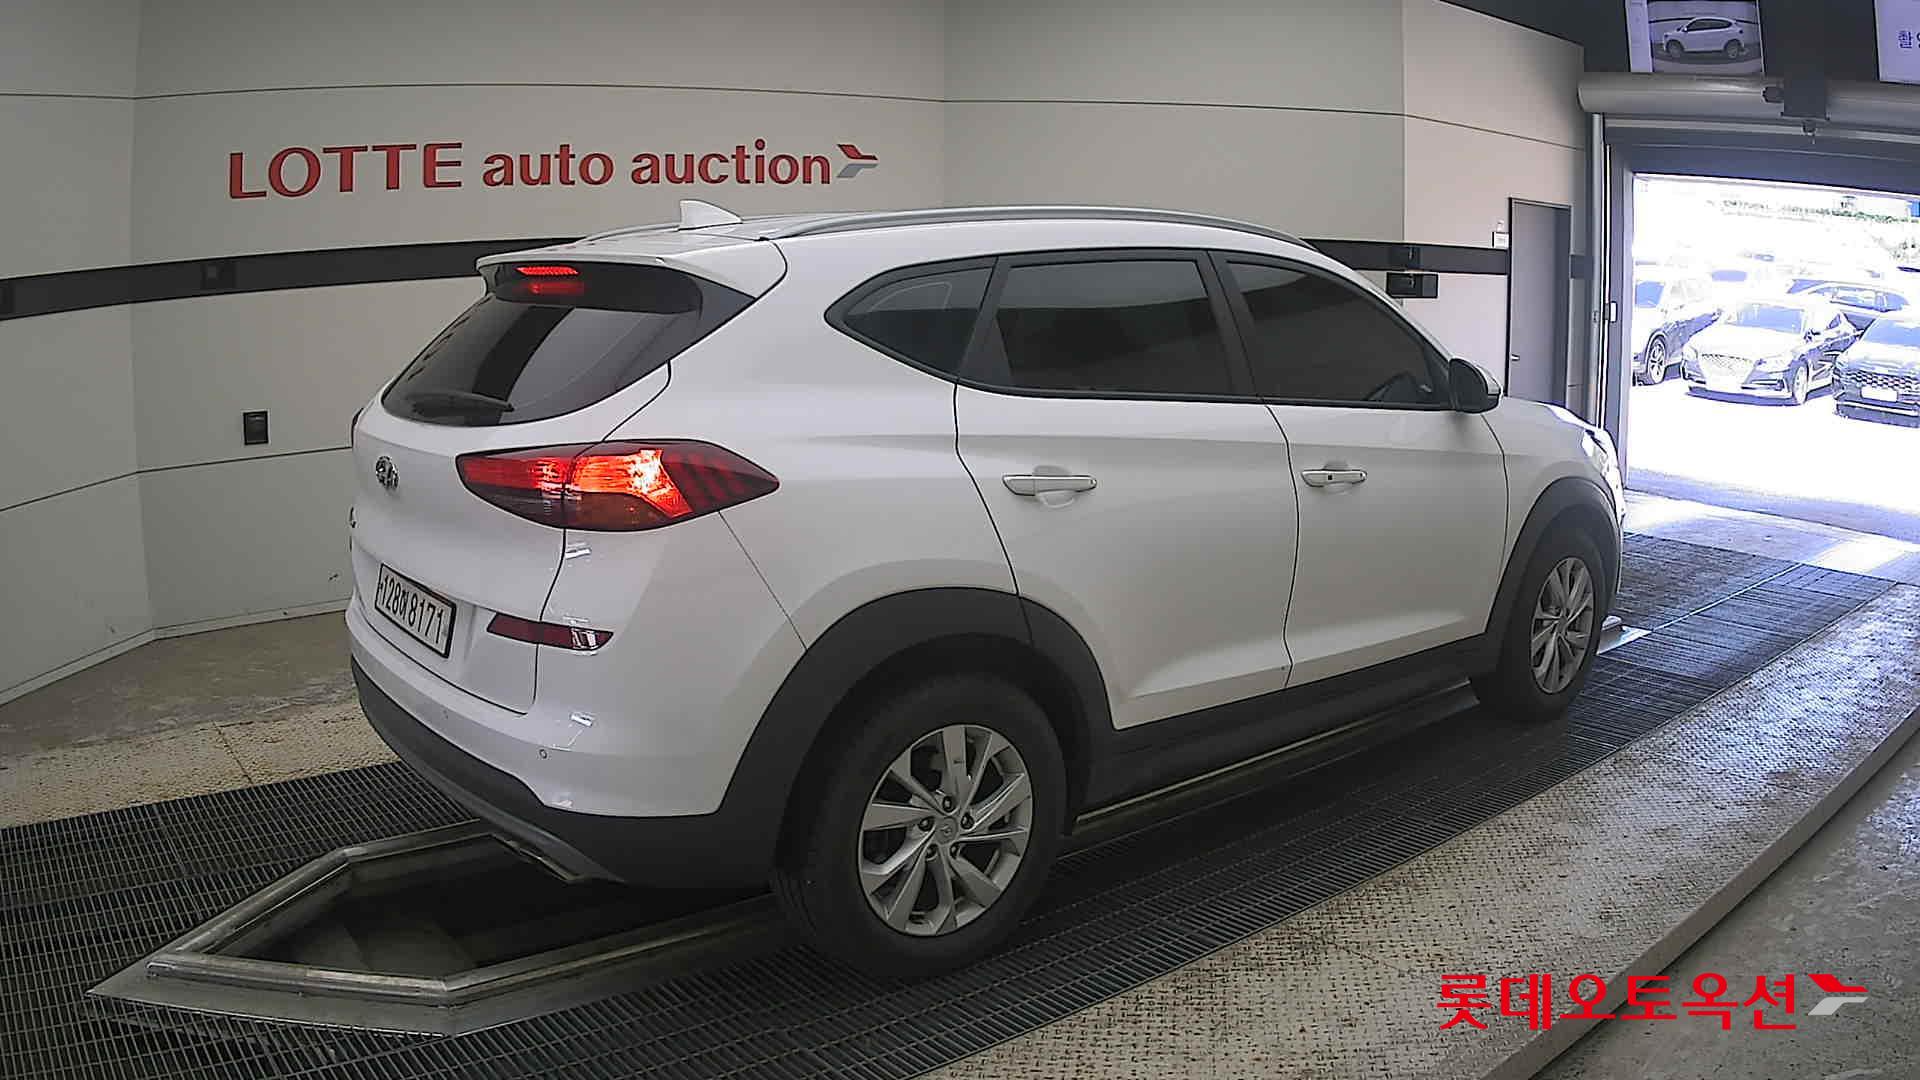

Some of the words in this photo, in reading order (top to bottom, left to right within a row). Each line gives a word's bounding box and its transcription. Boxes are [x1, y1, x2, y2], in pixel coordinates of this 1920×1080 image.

[229, 142, 462, 198] LOTTE
[483, 143, 614, 186] auto
[631, 139, 831, 185] auction
